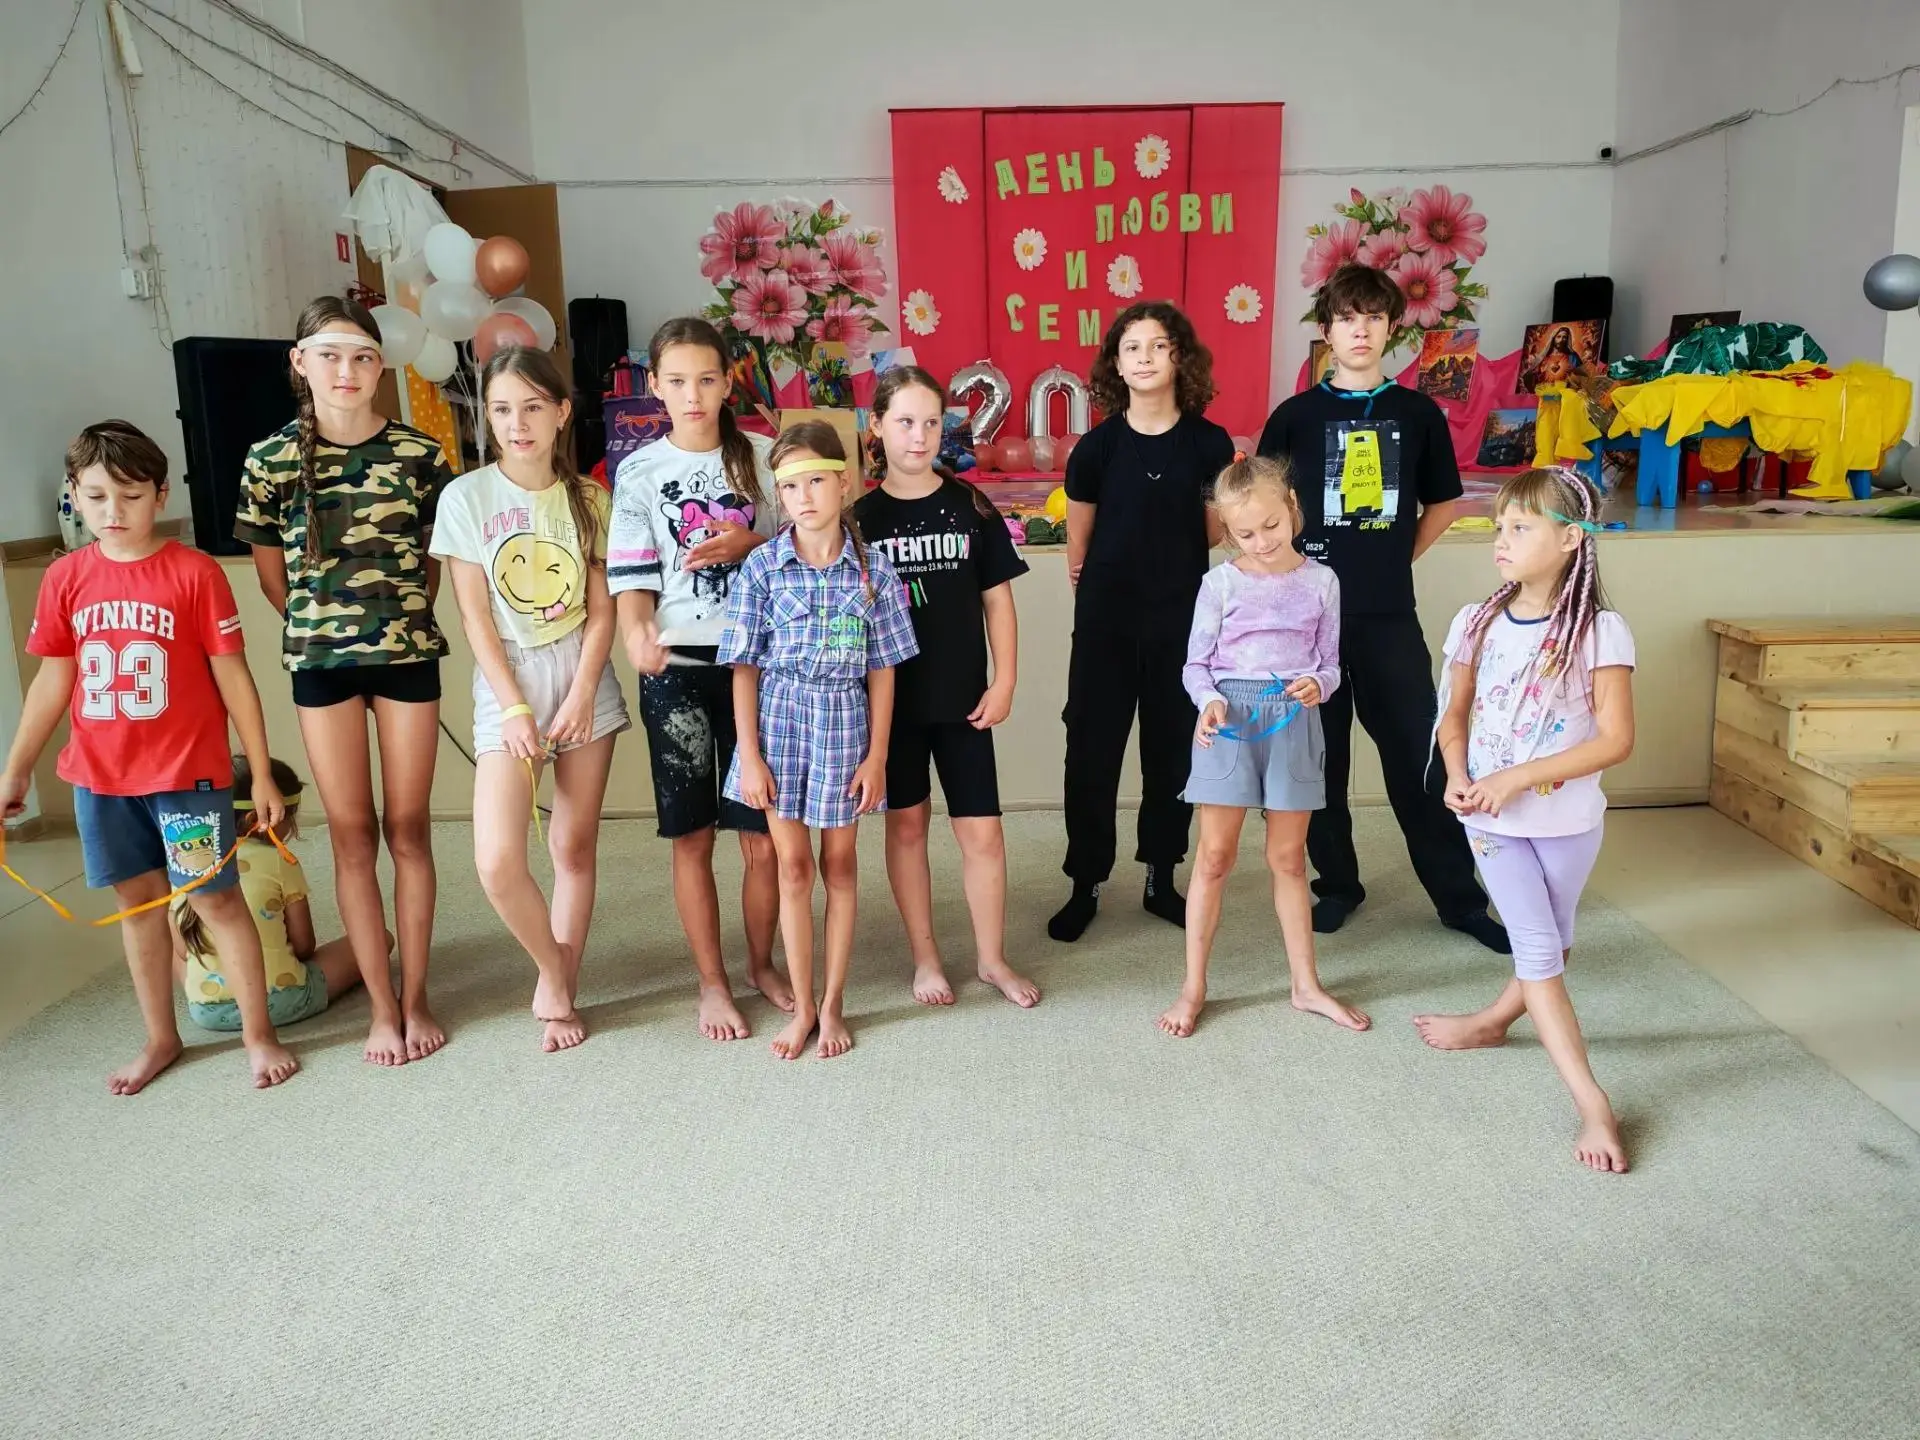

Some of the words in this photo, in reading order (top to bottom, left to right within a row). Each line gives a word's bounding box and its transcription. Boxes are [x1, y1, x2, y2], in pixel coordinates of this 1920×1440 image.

[994, 147, 1115, 200] ДЕНЬ
[1065, 250, 1088, 290] И
[483, 507, 530, 545] LIVE
[544, 514, 577, 543] LIF
[72, 600, 175, 640] WINNER
[81, 640, 169, 720] 23
